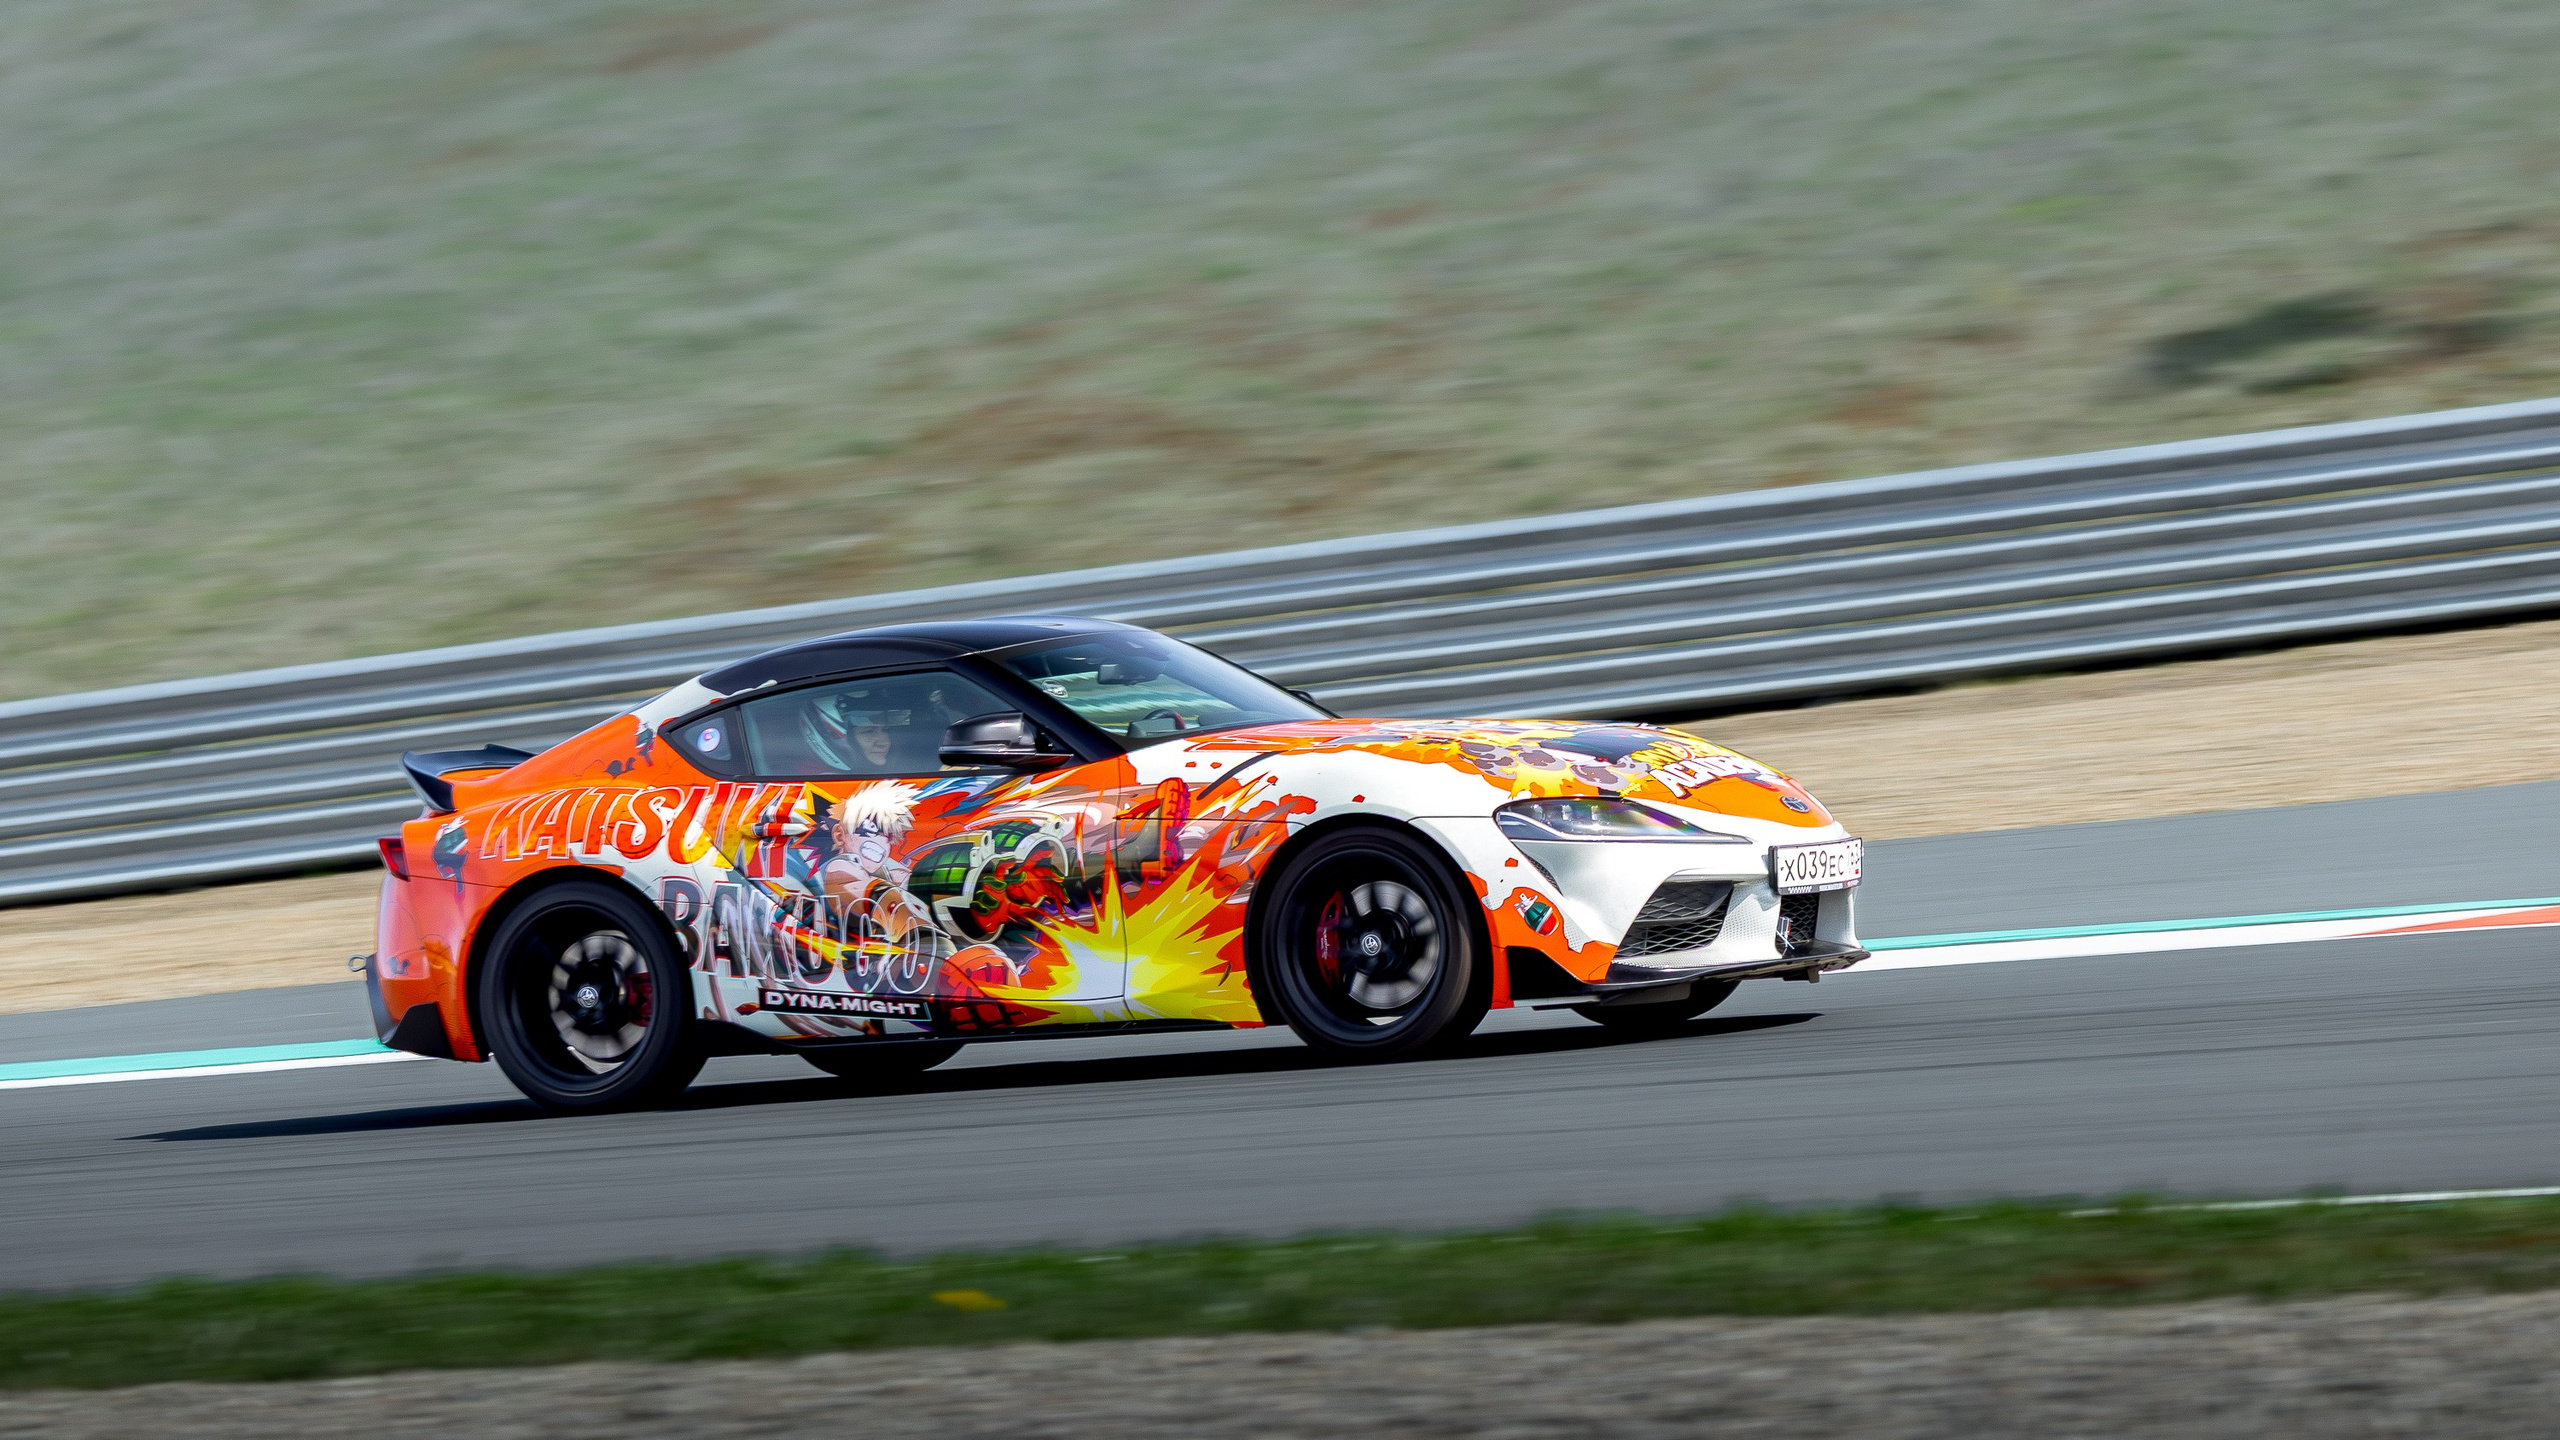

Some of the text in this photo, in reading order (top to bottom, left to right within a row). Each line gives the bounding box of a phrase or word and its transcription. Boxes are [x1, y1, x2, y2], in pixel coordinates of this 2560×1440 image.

[479, 781, 807, 880] KATSUKI
[659, 875, 937, 995] BAKUGO
[765, 991, 921, 1016] DYNA-MIGHT
